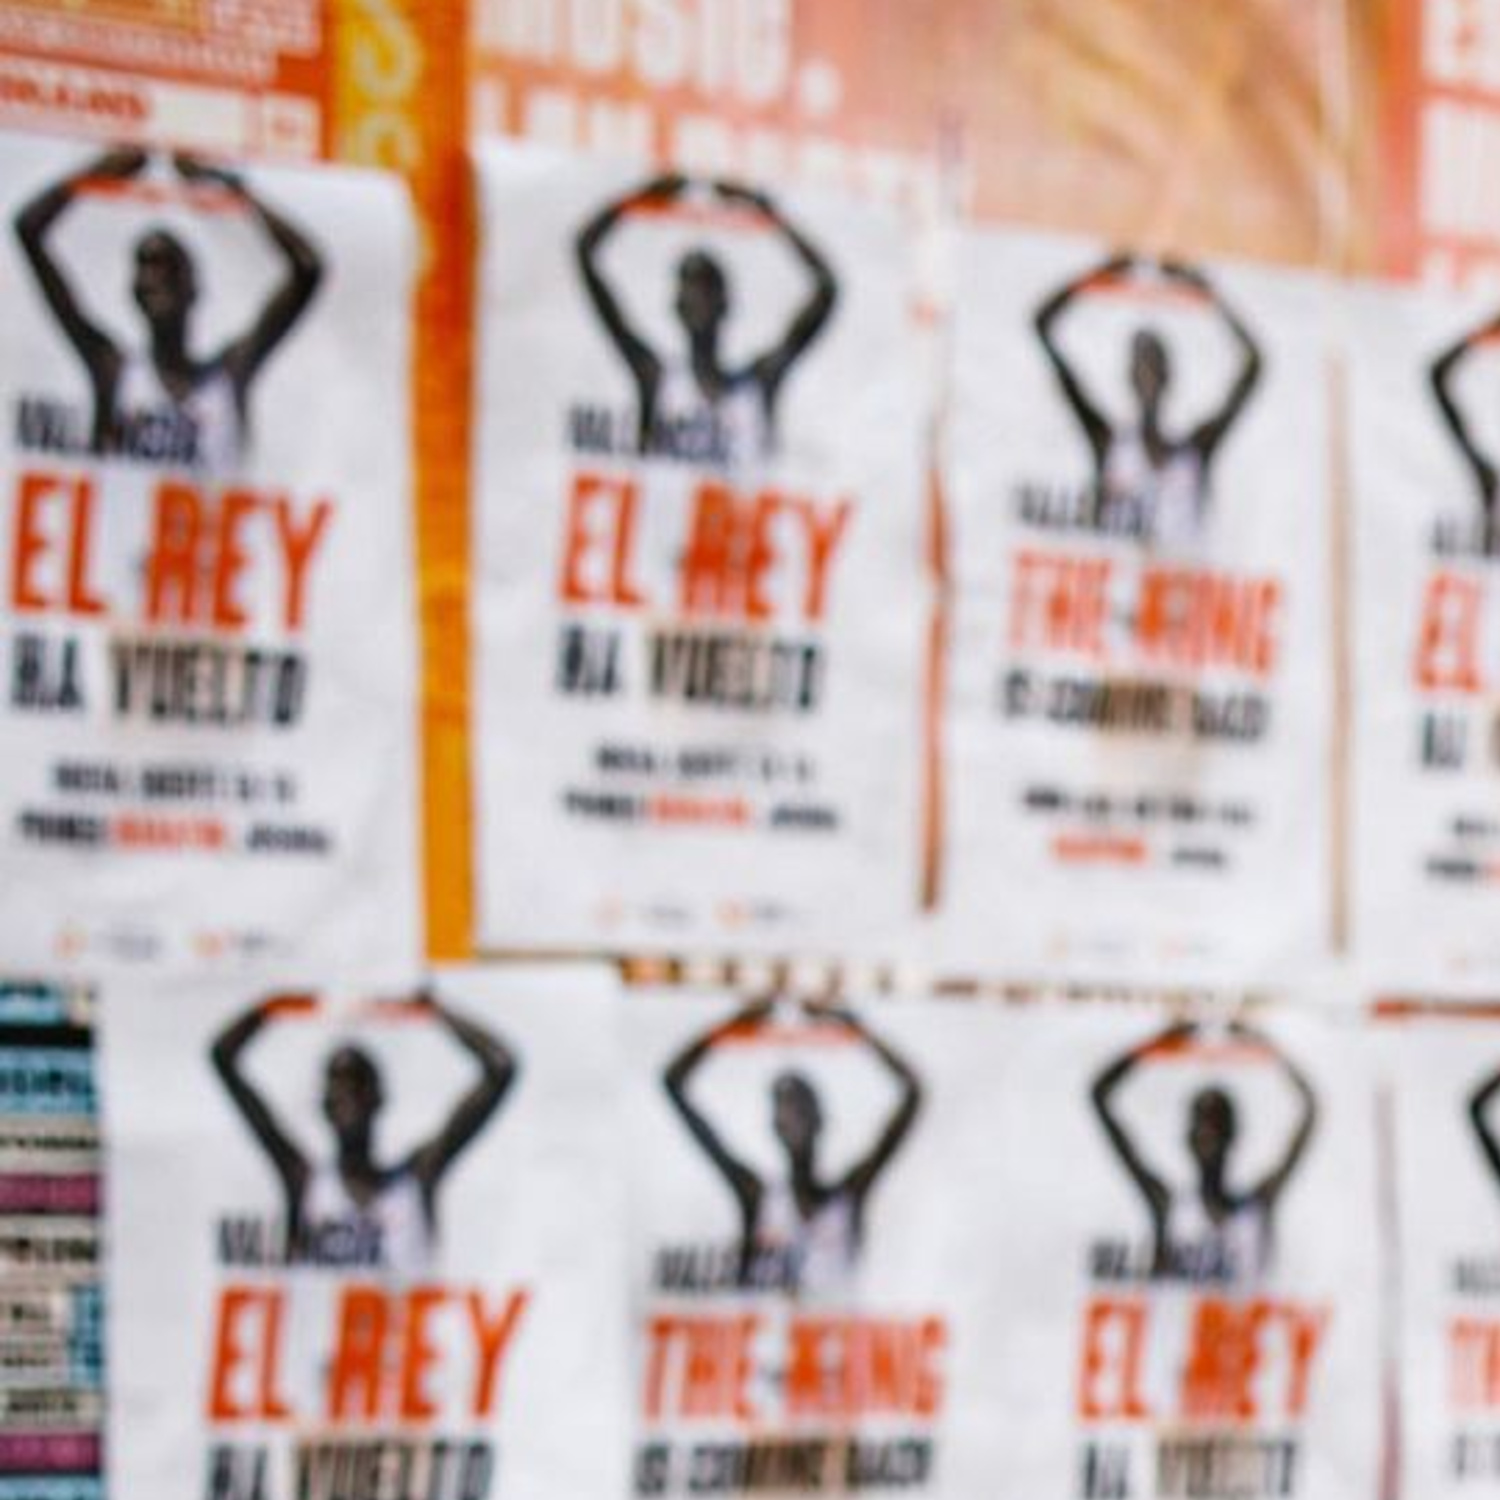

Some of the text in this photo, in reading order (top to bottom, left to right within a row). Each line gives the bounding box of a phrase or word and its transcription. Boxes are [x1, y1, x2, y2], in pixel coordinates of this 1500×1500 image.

[12, 472, 334, 630] EL REY
[560, 472, 856, 622] EL REY
[1010, 552, 1282, 678] THE KING
[1415, 570, 1482, 694] EL
[205, 1285, 532, 1424] EL REY
[642, 1314, 947, 1422] THE KING
[1078, 1297, 1330, 1425] EL REY
